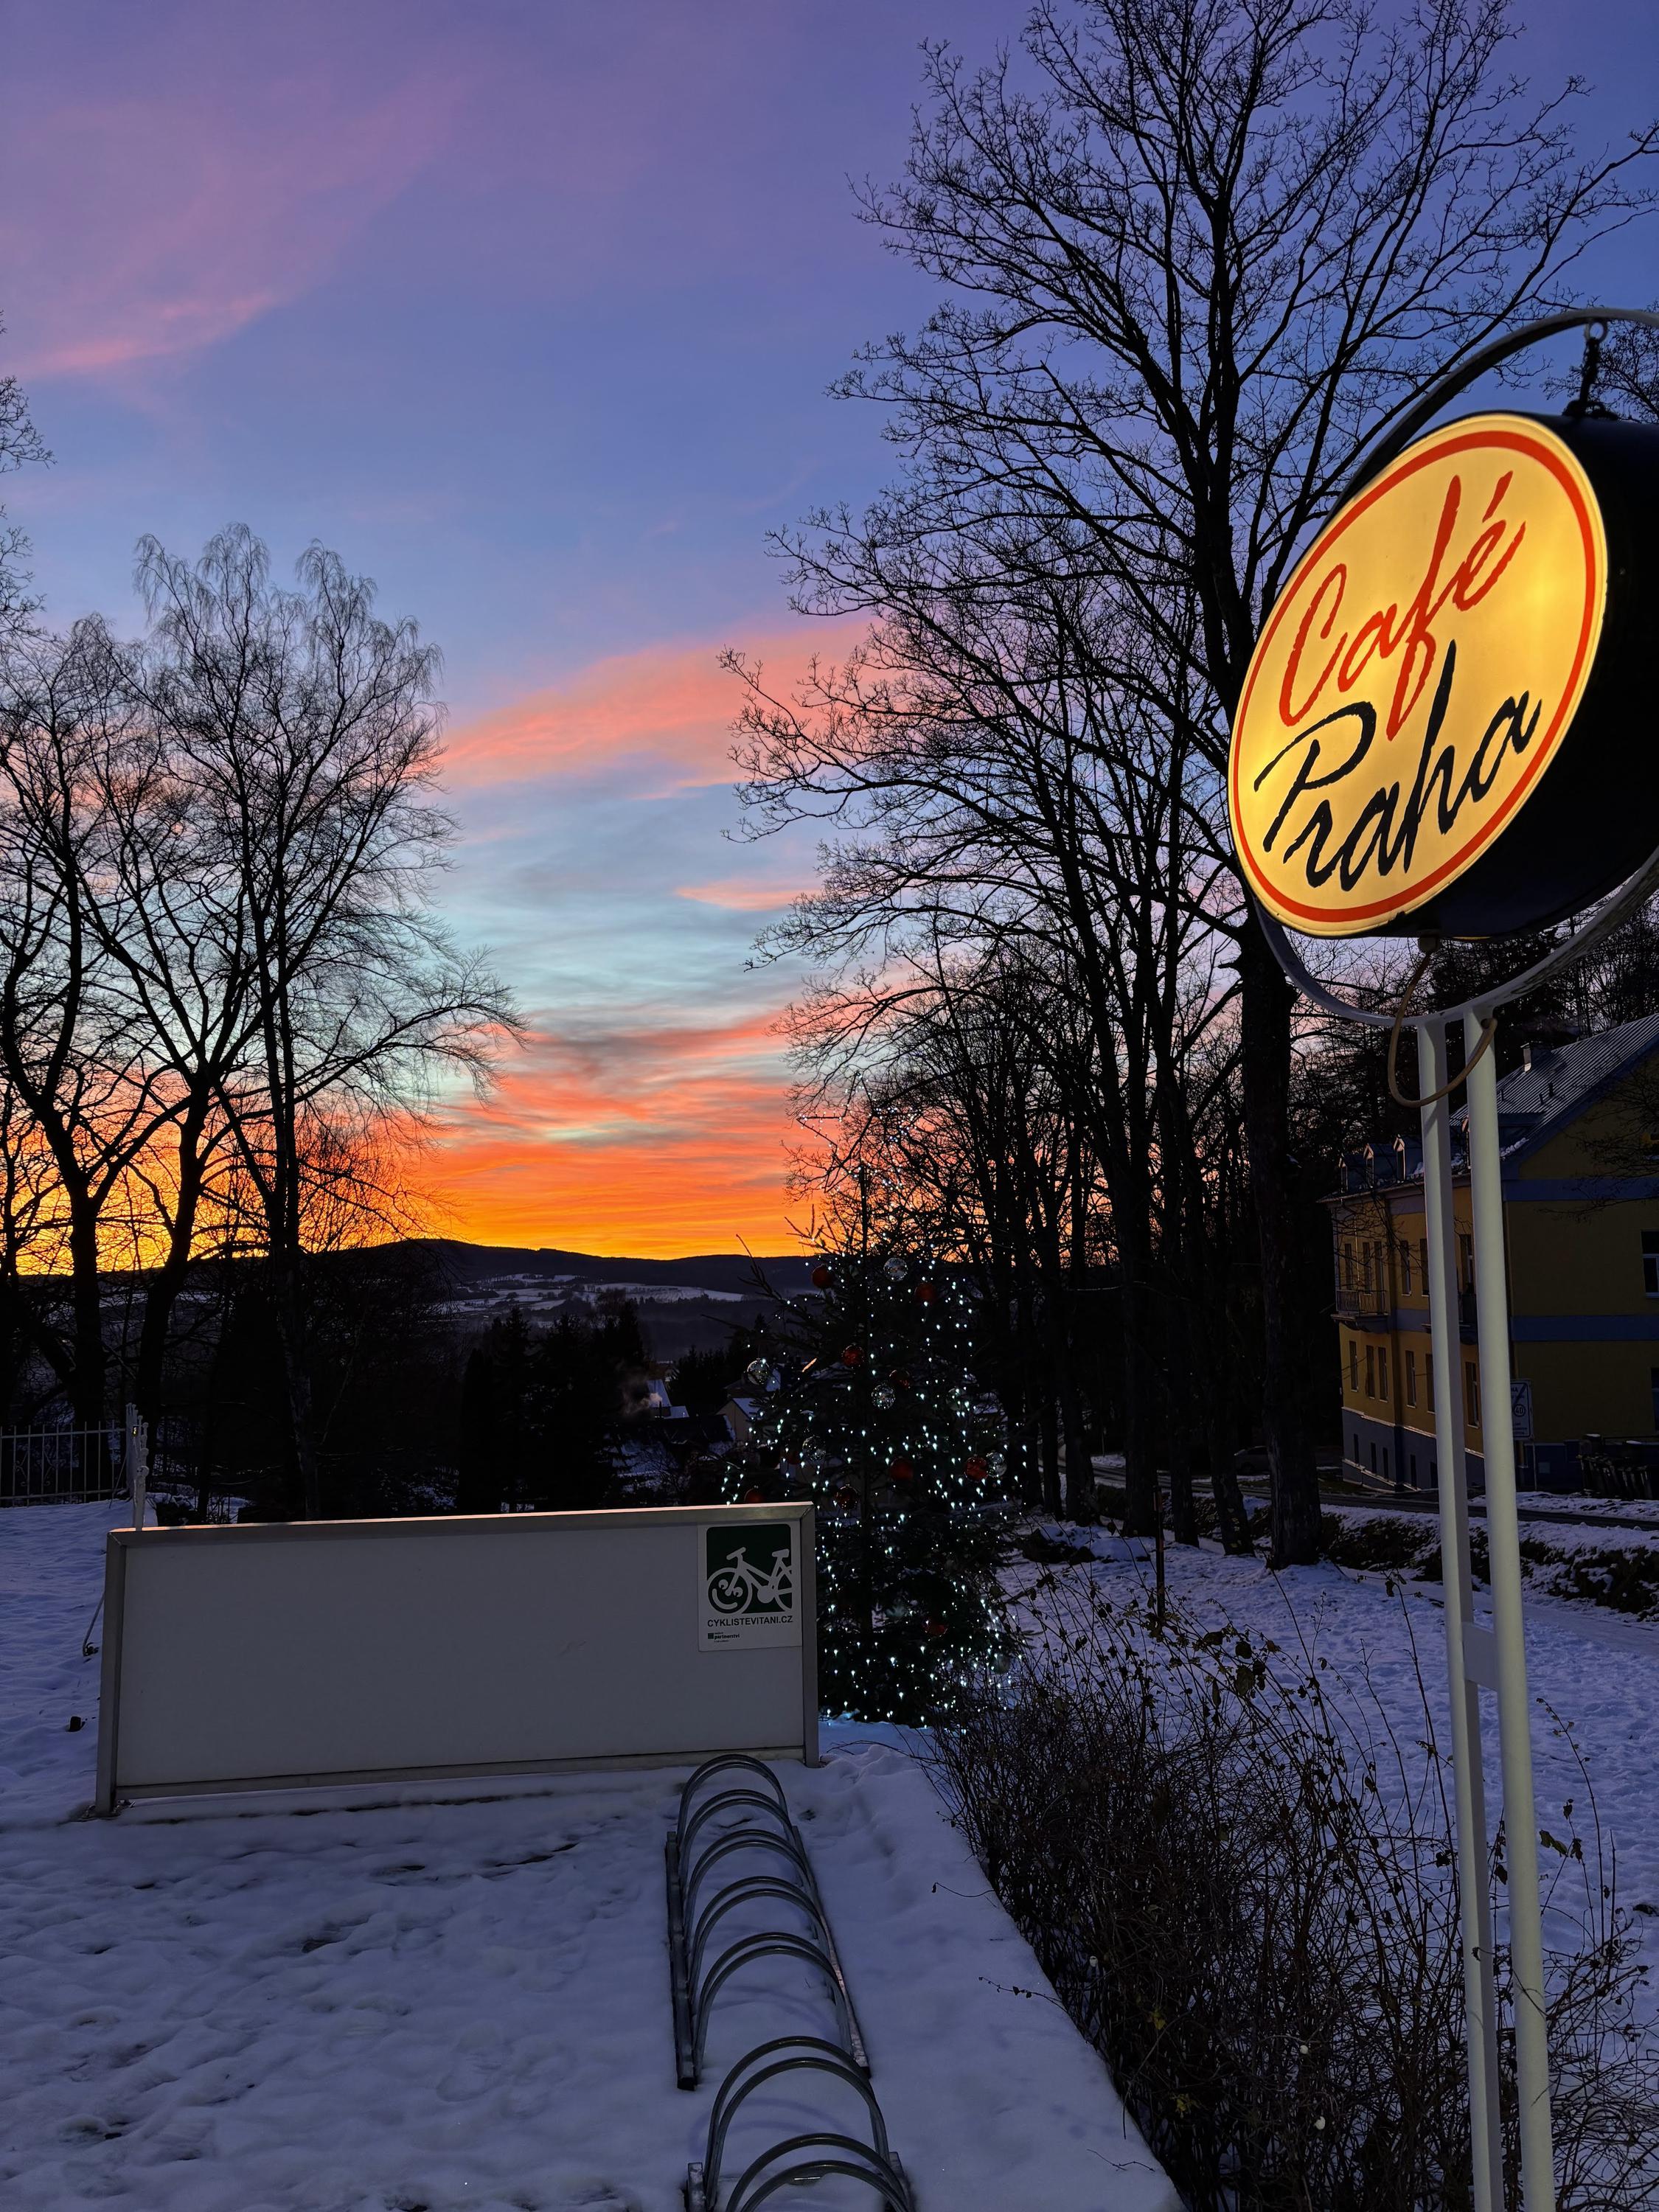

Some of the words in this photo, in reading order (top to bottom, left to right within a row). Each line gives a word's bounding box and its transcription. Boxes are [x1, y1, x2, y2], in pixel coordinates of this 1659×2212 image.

[1279, 470, 1526, 741] Café
[1254, 641, 1542, 891] Praha
[707, 1615, 793, 1627] CYKLISTEVITANI.CZ
